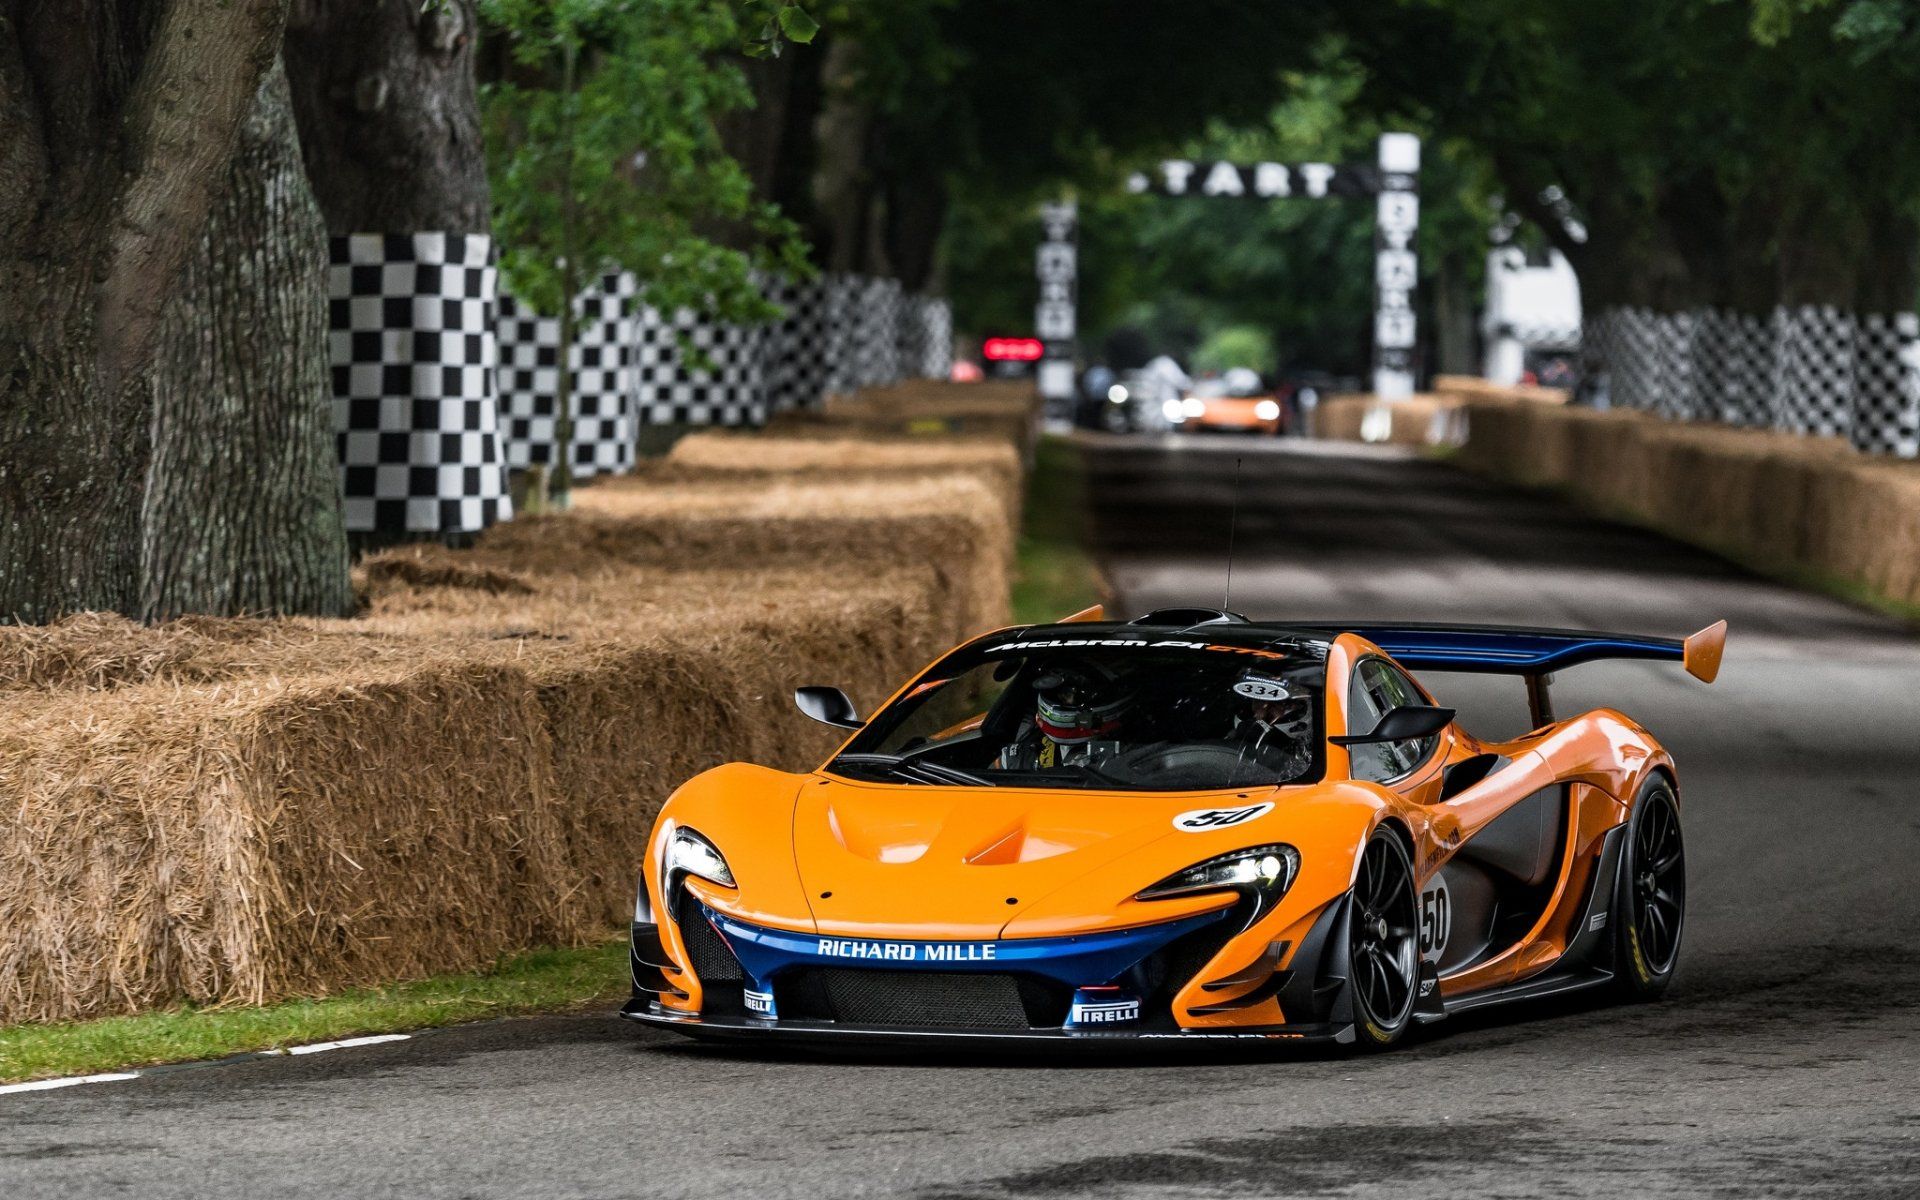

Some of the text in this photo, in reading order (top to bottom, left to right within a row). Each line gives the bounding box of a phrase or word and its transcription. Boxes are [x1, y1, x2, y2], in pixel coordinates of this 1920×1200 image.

[1242, 684, 1279, 698] 334
[1182, 805, 1266, 827] 50
[1420, 887, 1447, 954] 50
[817, 939, 996, 961] RICHARD MILLE
[1073, 1000, 1139, 1023] PIRELLI
